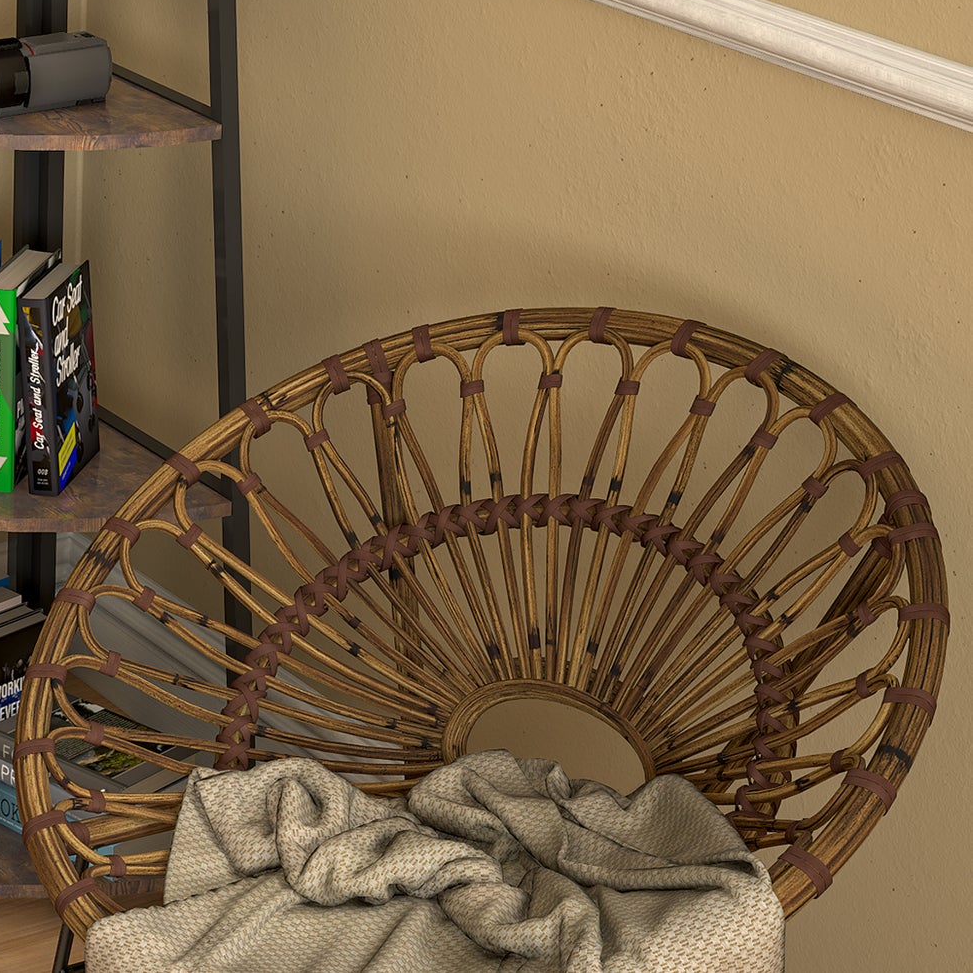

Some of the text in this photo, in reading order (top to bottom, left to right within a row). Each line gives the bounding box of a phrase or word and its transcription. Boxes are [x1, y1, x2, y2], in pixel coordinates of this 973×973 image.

[52, 274, 83, 327] Car Seat
[54, 315, 69, 357] and
[56, 342, 81, 387] Stroller
[28, 342, 45, 450] Car Seat and Stroller
[3, 744, 14, 759] F
